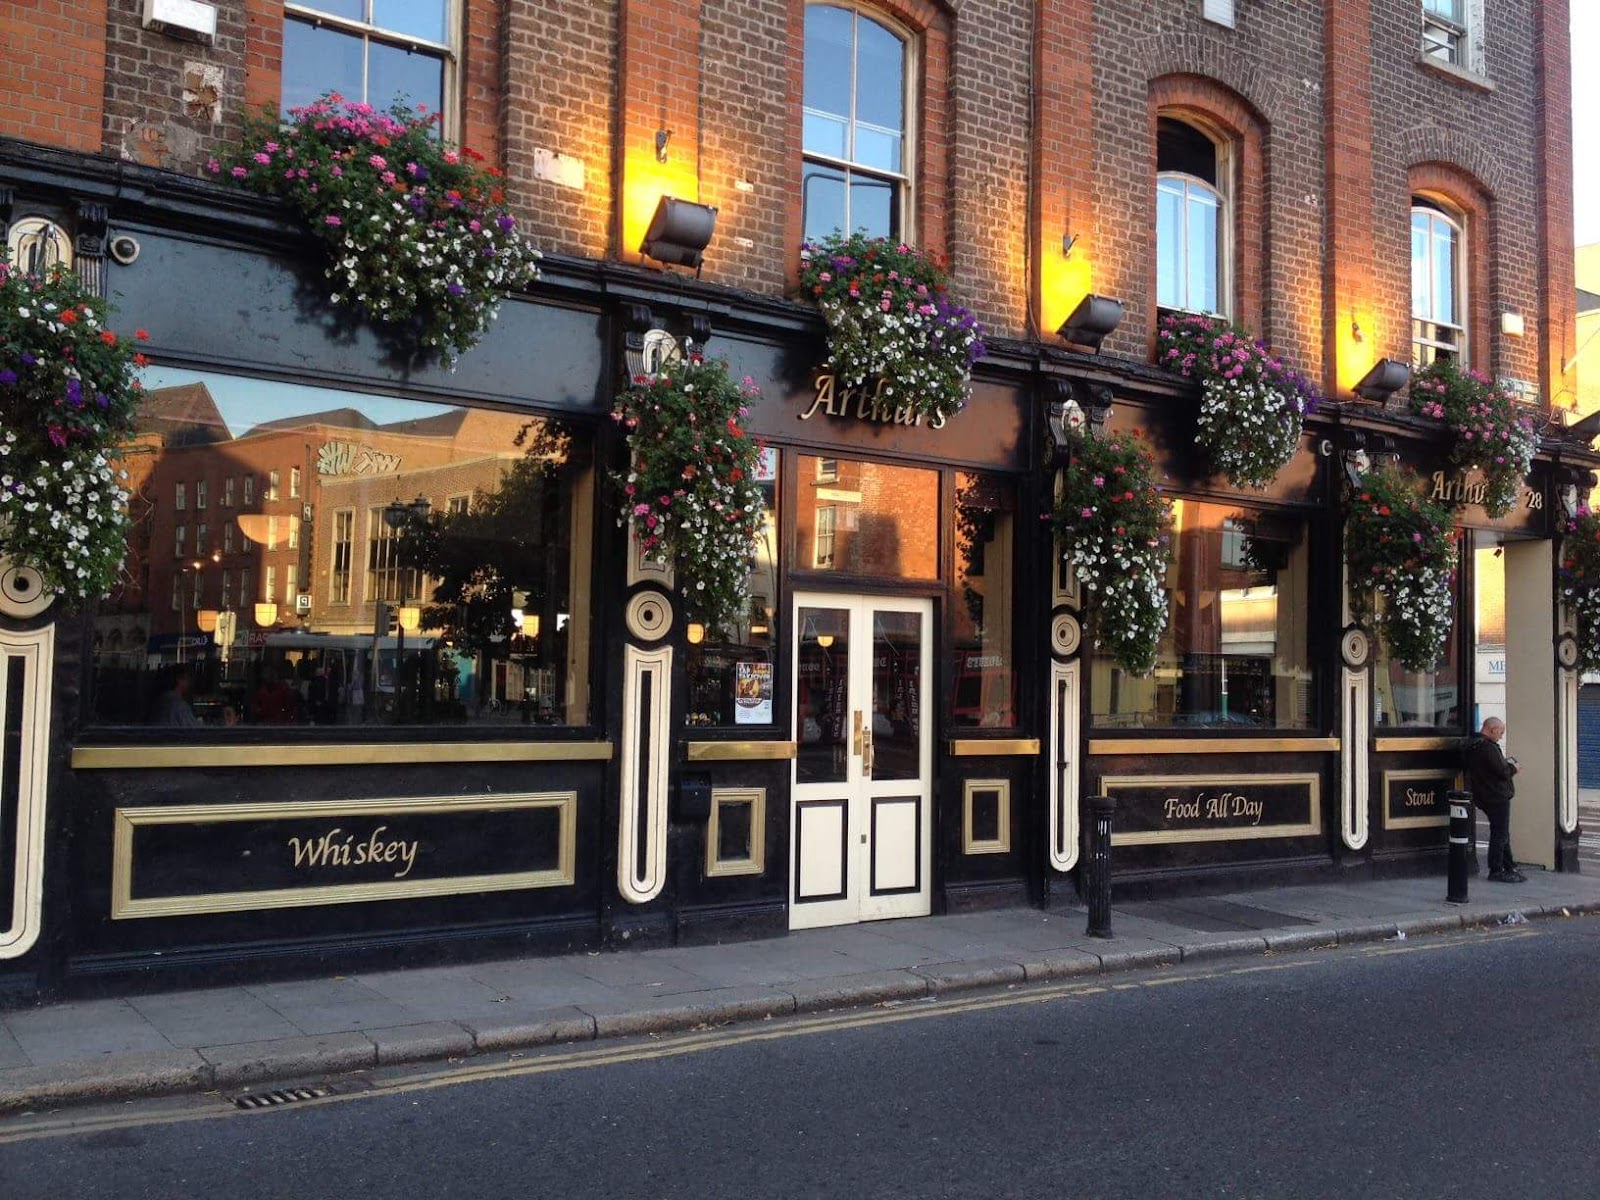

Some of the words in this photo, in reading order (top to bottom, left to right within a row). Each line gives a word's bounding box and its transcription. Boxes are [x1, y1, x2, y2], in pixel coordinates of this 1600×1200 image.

[1528, 491, 1543, 510] 28
[1163, 792, 1204, 819] Food
[1206, 792, 1232, 819] All
[1231, 796, 1264, 826] Day
[1405, 787, 1436, 807] Stout
[287, 826, 418, 878] Whiskey
